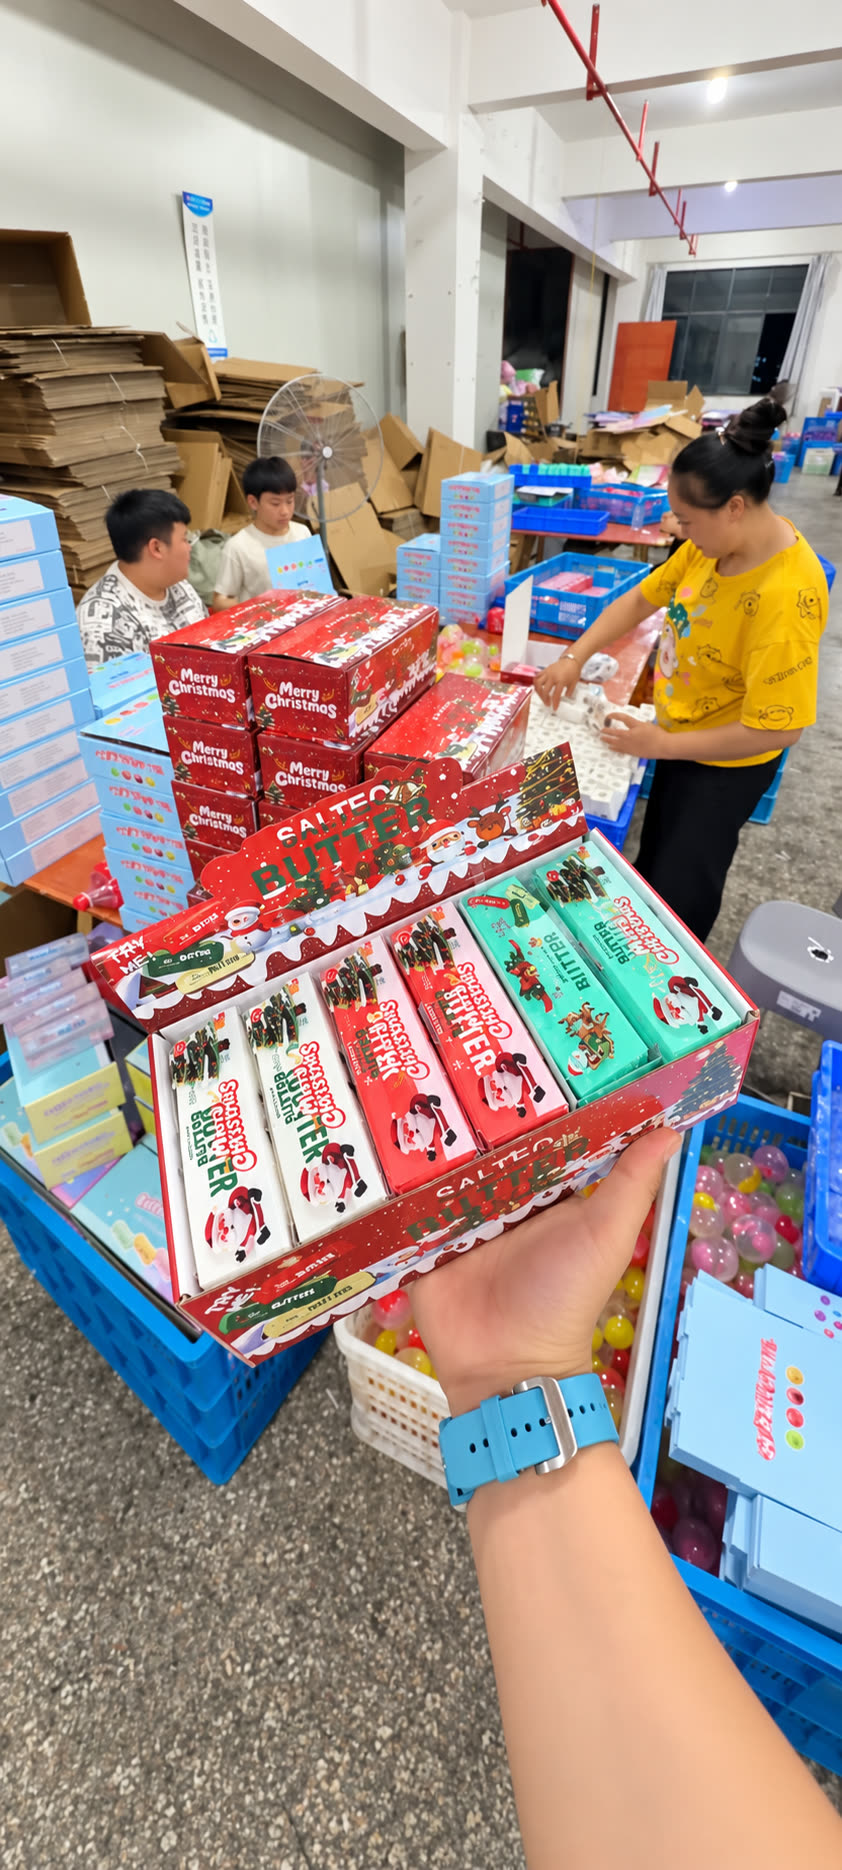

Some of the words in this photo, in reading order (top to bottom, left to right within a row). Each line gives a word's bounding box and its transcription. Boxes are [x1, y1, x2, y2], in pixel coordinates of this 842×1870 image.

[181, 668, 218, 688] Merry
[168, 680, 236, 703] Christmas
[279, 682, 320, 702] Merry
[265, 693, 337, 719] Christmas
[192, 741, 228, 760] Merry
[181, 751, 244, 775] Christmas
[289, 761, 329, 781] Merry
[189, 814, 247, 839] Christmas
[199, 806, 232, 824] Merry
[251, 796, 437, 900] BUTTER
[106, 935, 145, 963] TRY
